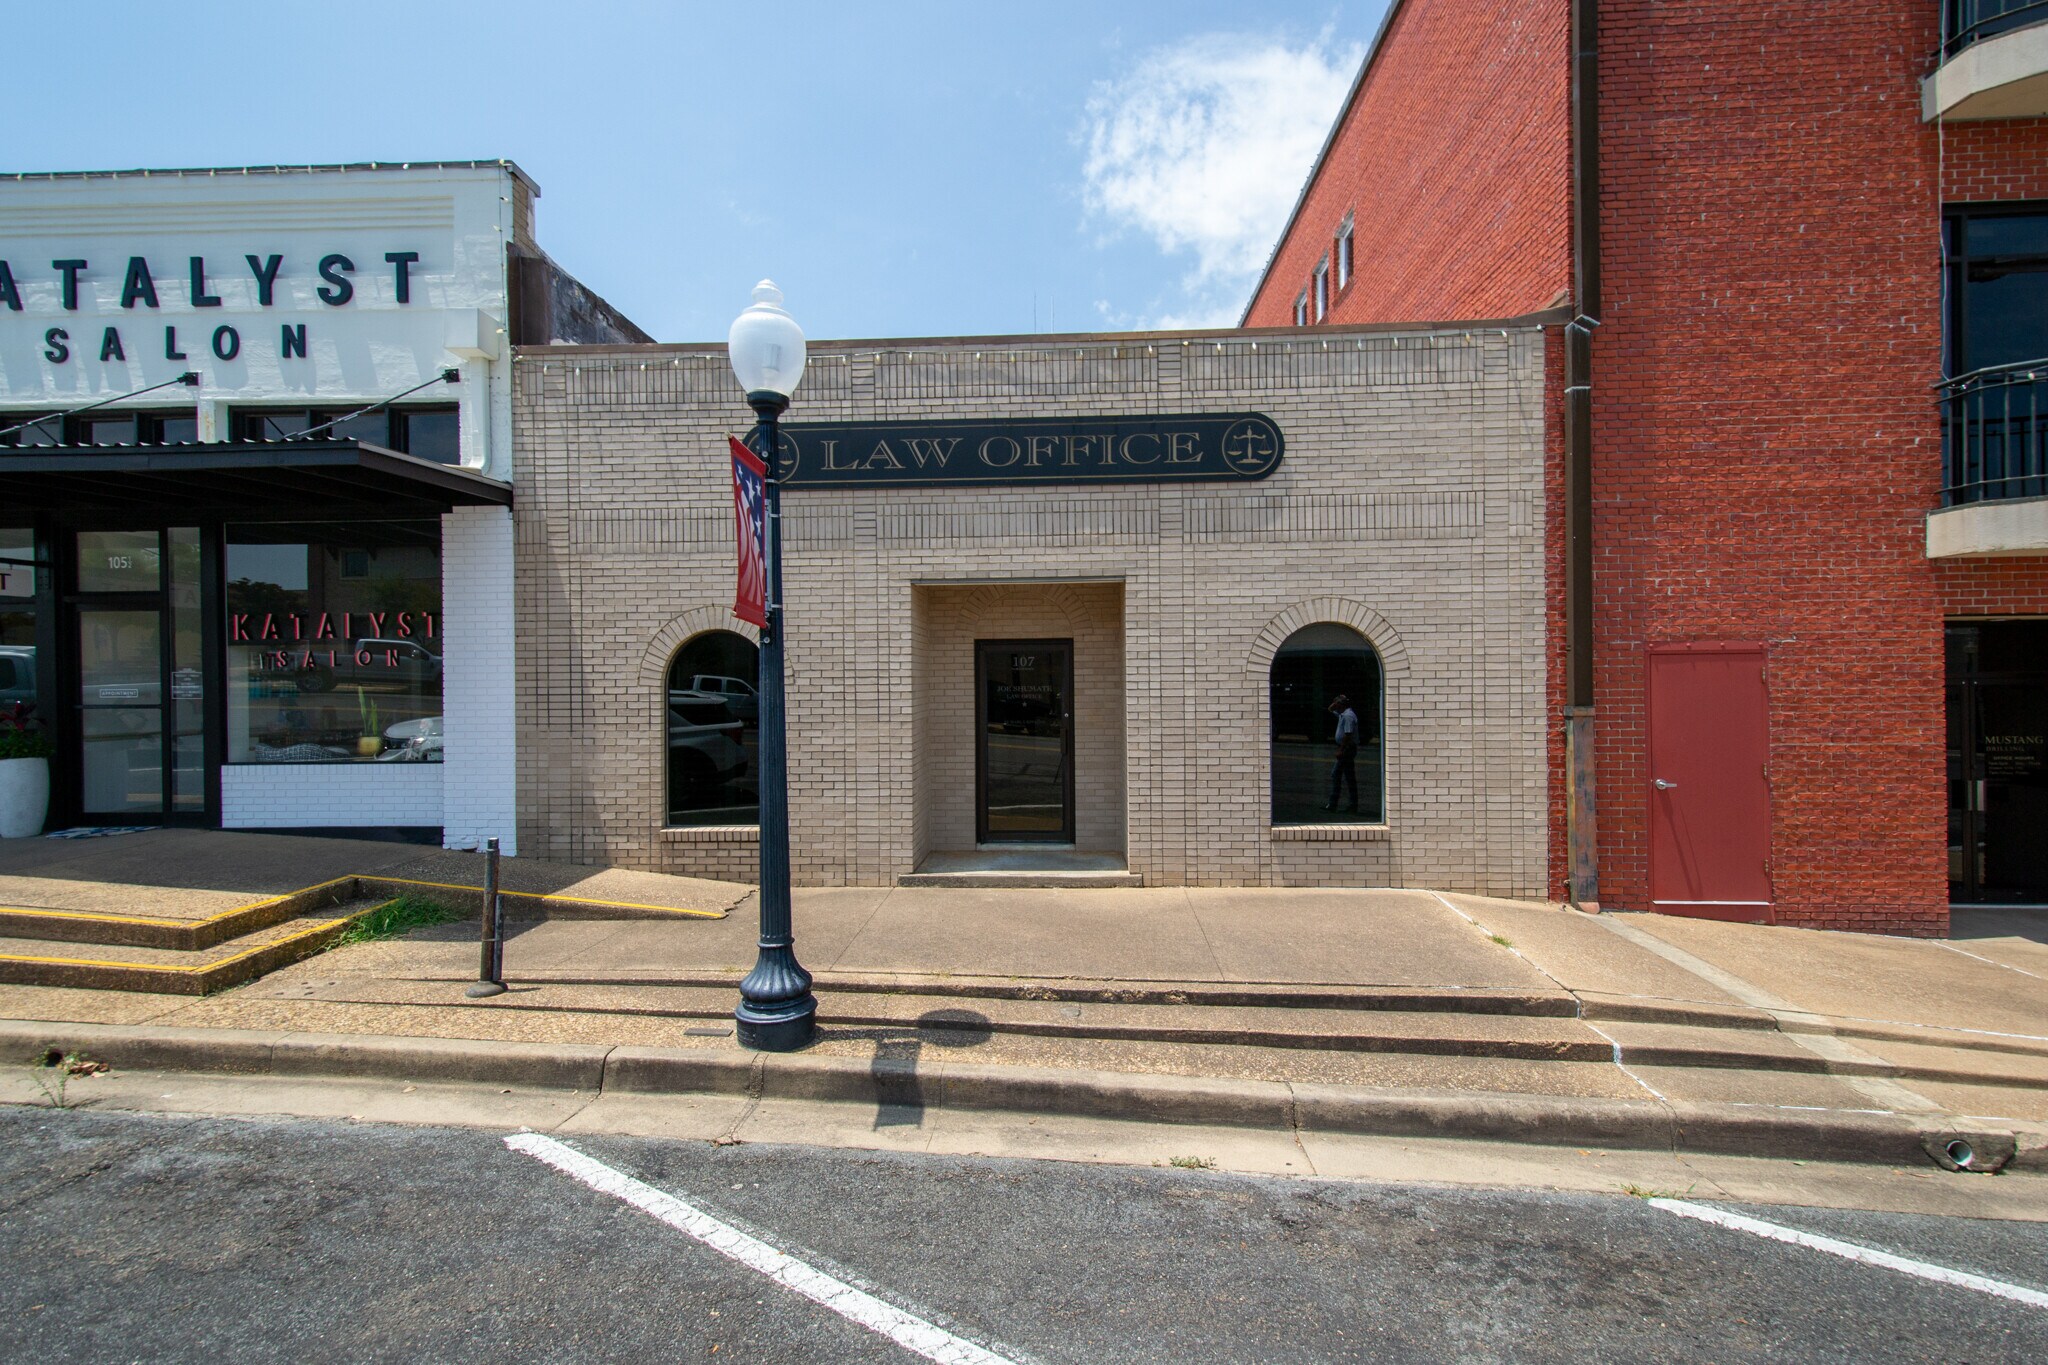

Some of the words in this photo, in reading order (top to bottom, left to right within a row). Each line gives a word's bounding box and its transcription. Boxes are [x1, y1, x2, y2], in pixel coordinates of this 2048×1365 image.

[44, 323, 307, 364] SALON
[820, 437, 963, 470] LAW
[978, 431, 1204, 468] OFFICE
[233, 612, 439, 641] KATALYST
[276, 649, 401, 669] SALON
[1013, 656, 1035, 667] 107
[1984, 735, 2044, 744] MUSTANG
